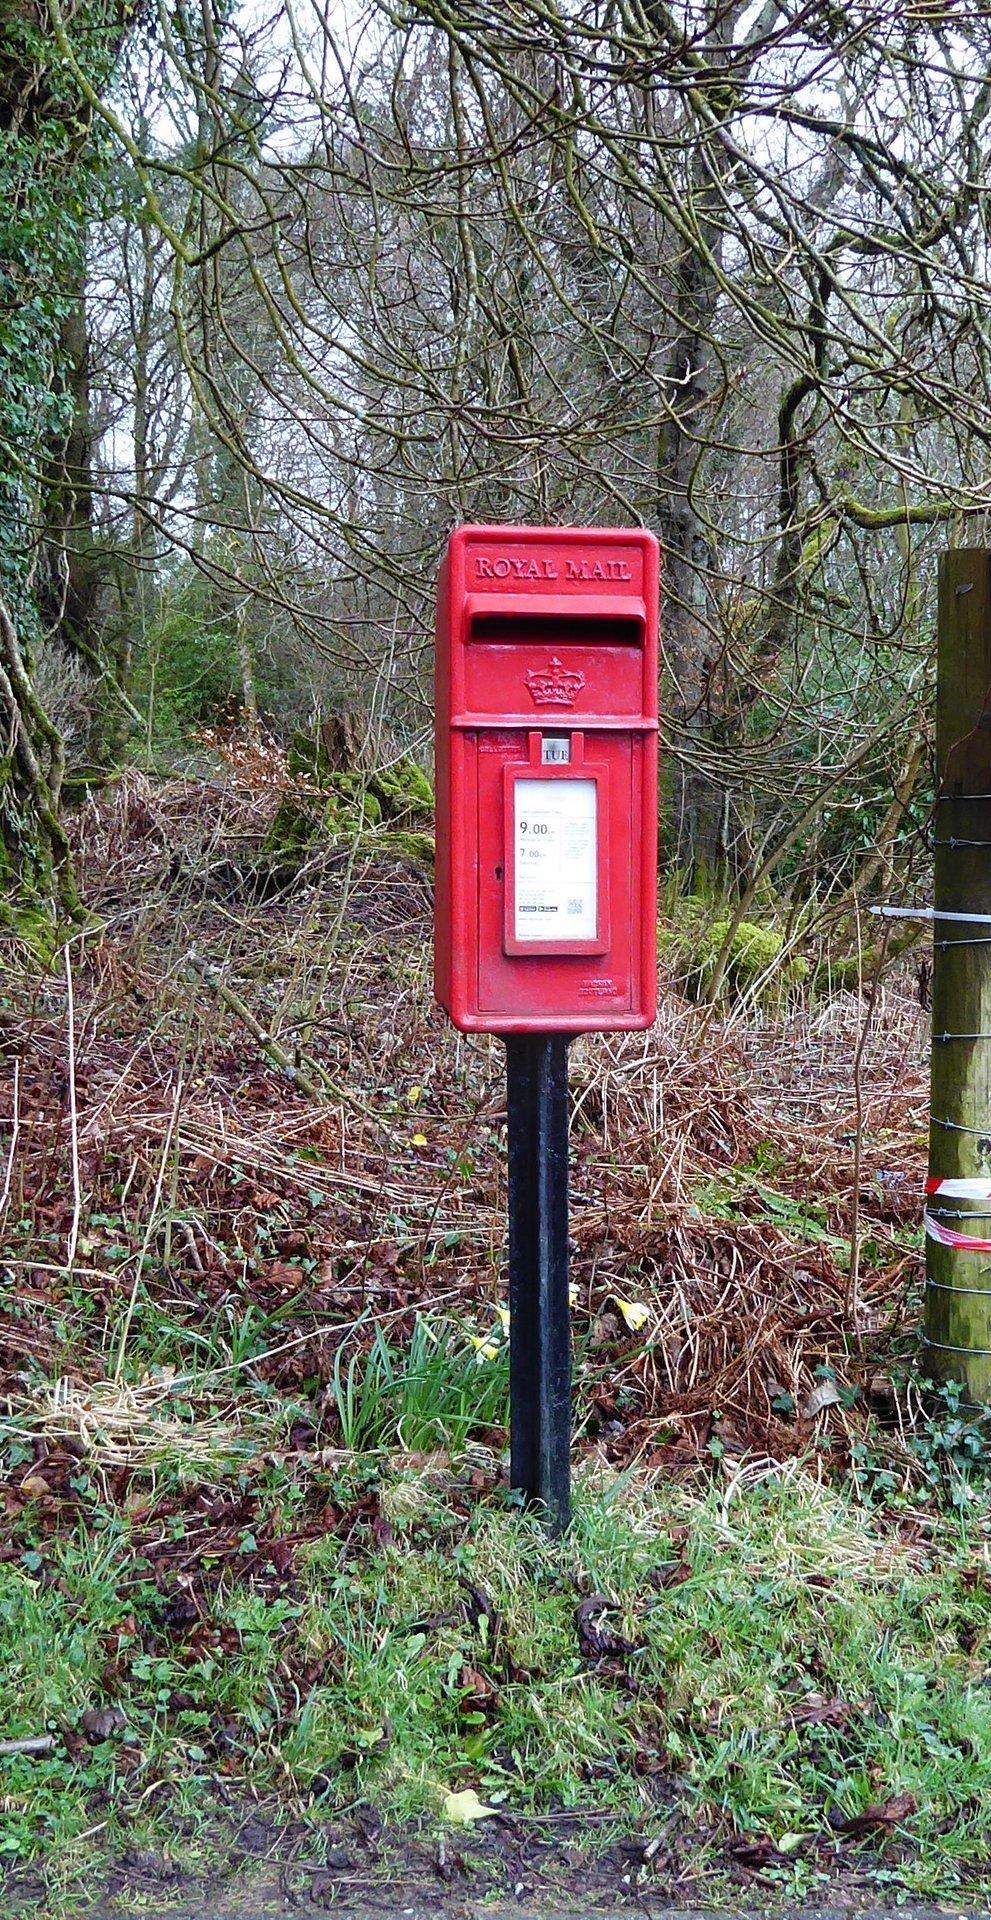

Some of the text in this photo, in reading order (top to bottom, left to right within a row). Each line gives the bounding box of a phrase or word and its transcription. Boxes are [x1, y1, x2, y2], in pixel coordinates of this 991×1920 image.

[475, 557, 632, 582] ROYAL MAIL
[543, 749, 568, 761] TUE
